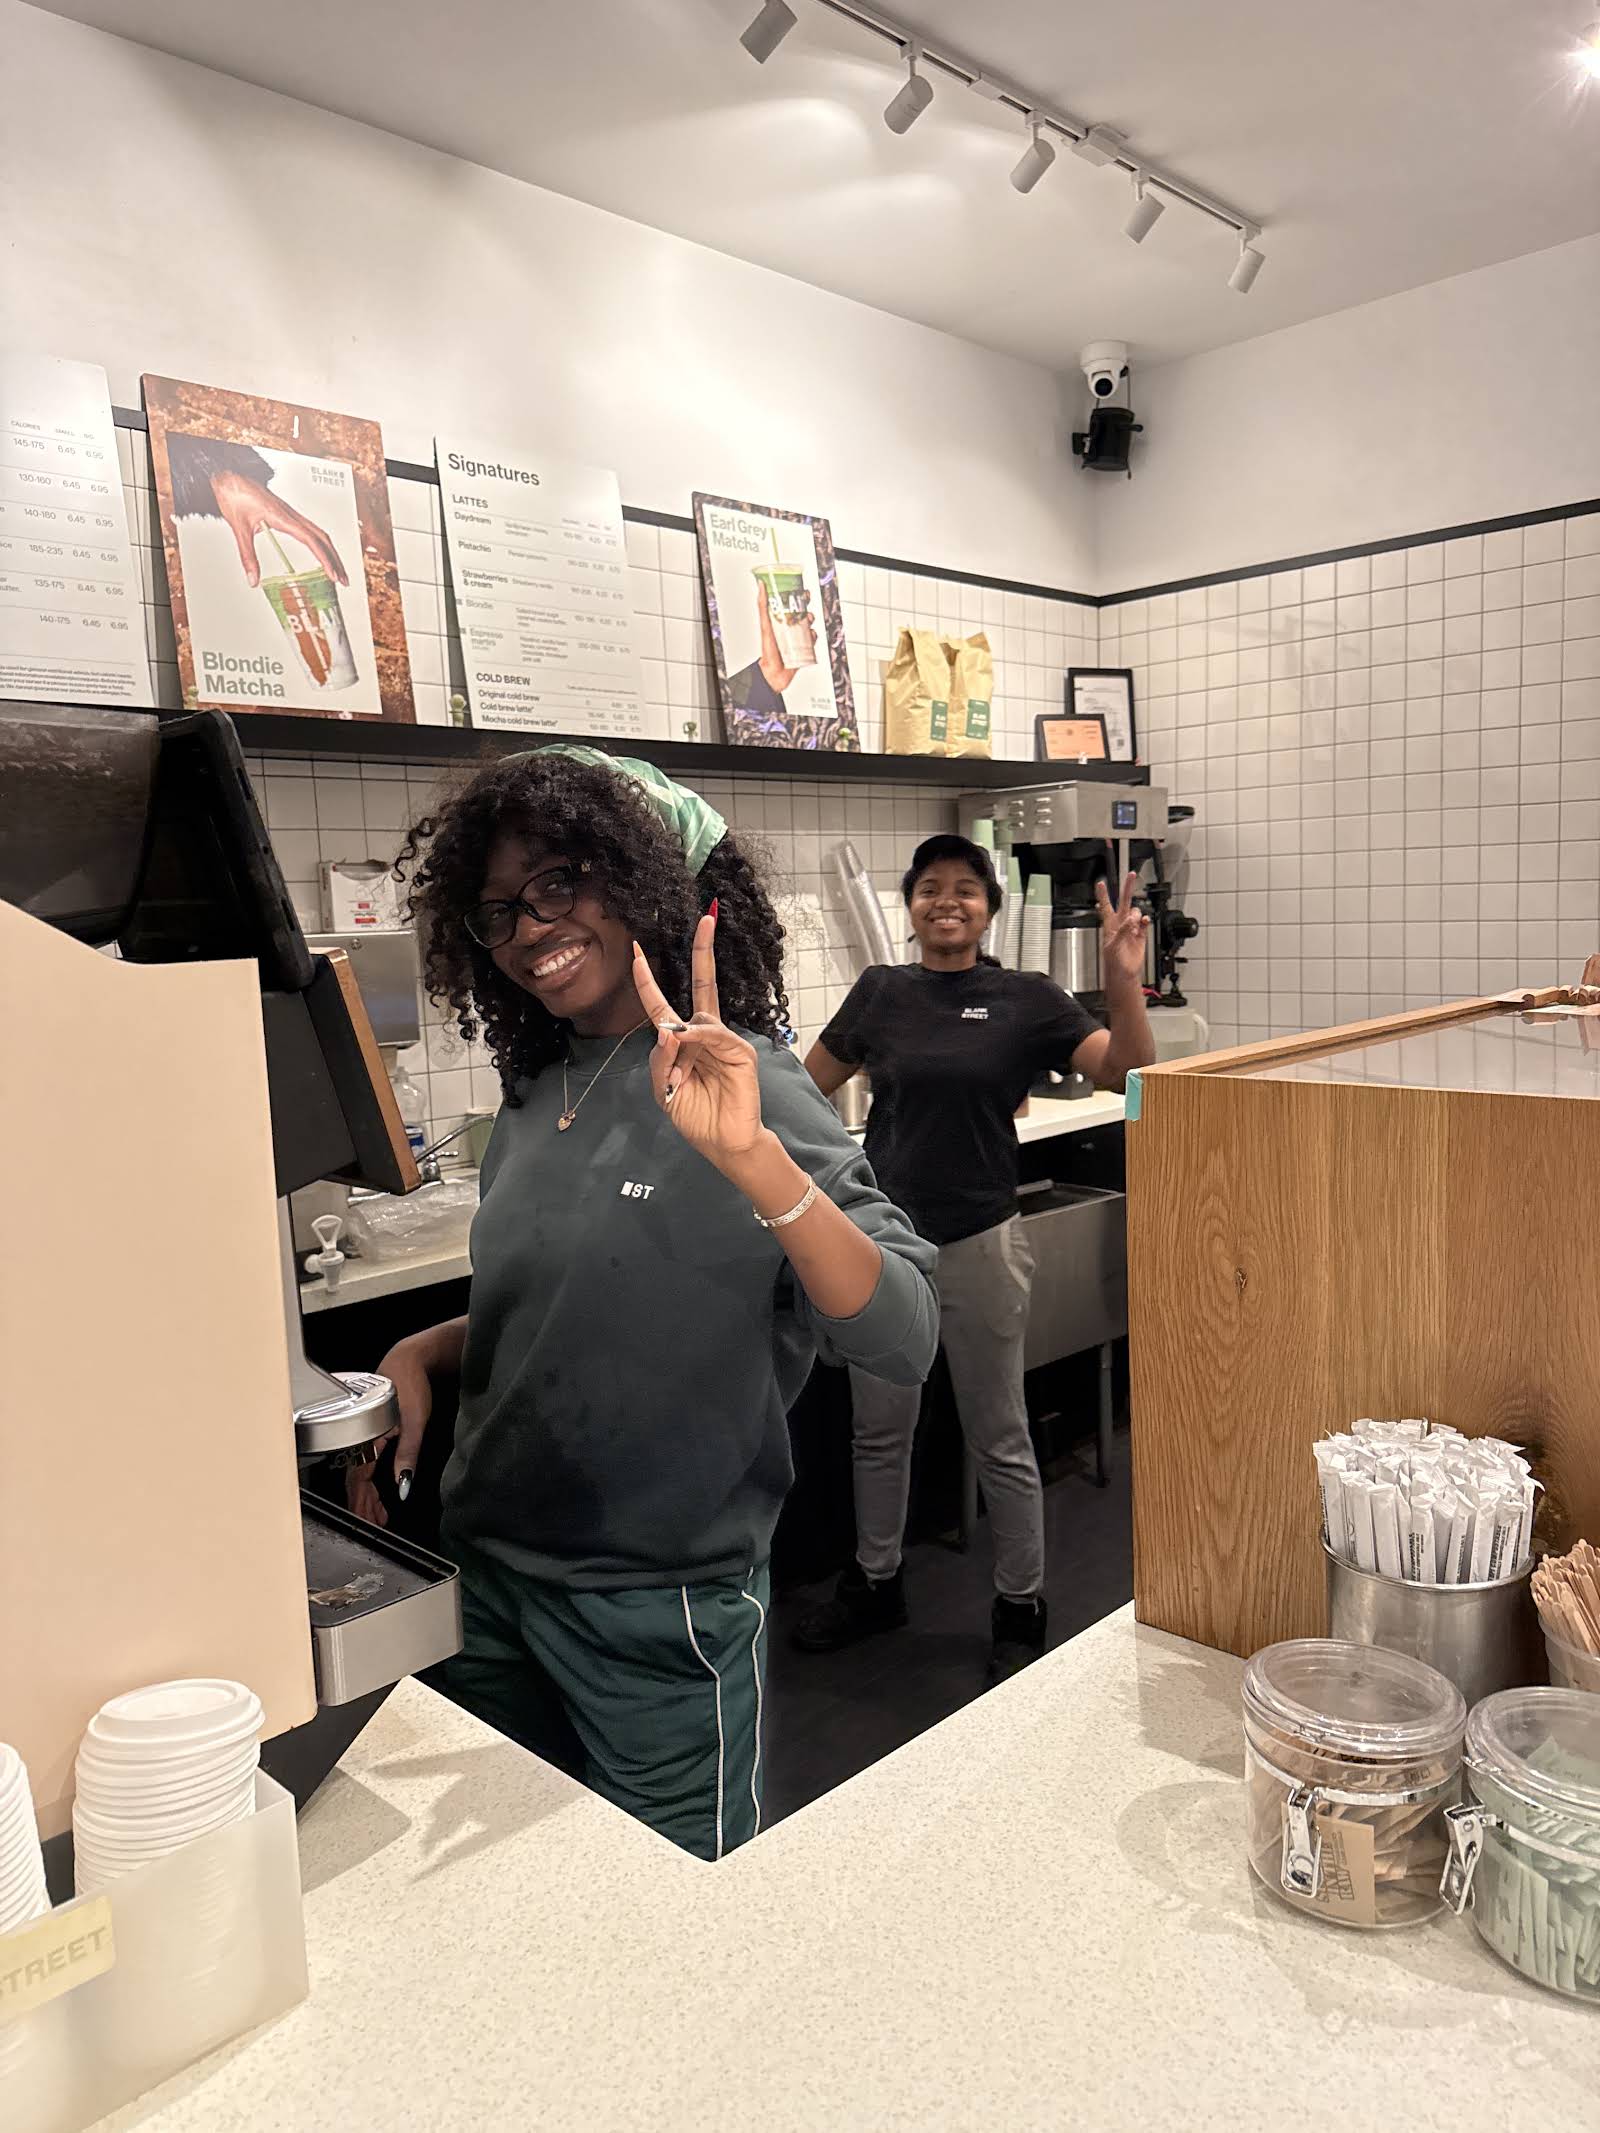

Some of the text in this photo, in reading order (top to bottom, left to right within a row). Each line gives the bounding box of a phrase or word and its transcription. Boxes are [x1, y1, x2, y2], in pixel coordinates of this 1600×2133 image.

[13, 438, 45, 450] 145-175
[448, 453, 540, 486] Signatures
[311, 475, 345, 488] STREET
[452, 494, 489, 508] LATTES
[67, 514, 86, 524] 6.45
[95, 518, 114, 528] 6.95
[454, 511, 491, 525] Daydream
[710, 514, 767, 541] Earl Grey
[458, 541, 491, 553] Pistachio
[712, 530, 760, 552] Matcha
[462, 569, 508, 583] Strawberries
[470, 580, 493, 589] cream
[202, 651, 284, 675] Blondie
[205, 674, 285, 697] Matcha
[476, 672, 530, 686] COLD BREW
[479, 689, 505, 700] Original
[480, 702, 497, 710] Cold
[482, 715, 506, 724] Mocha
[507, 717, 522, 725] cold
[523, 718, 540, 726] brew
